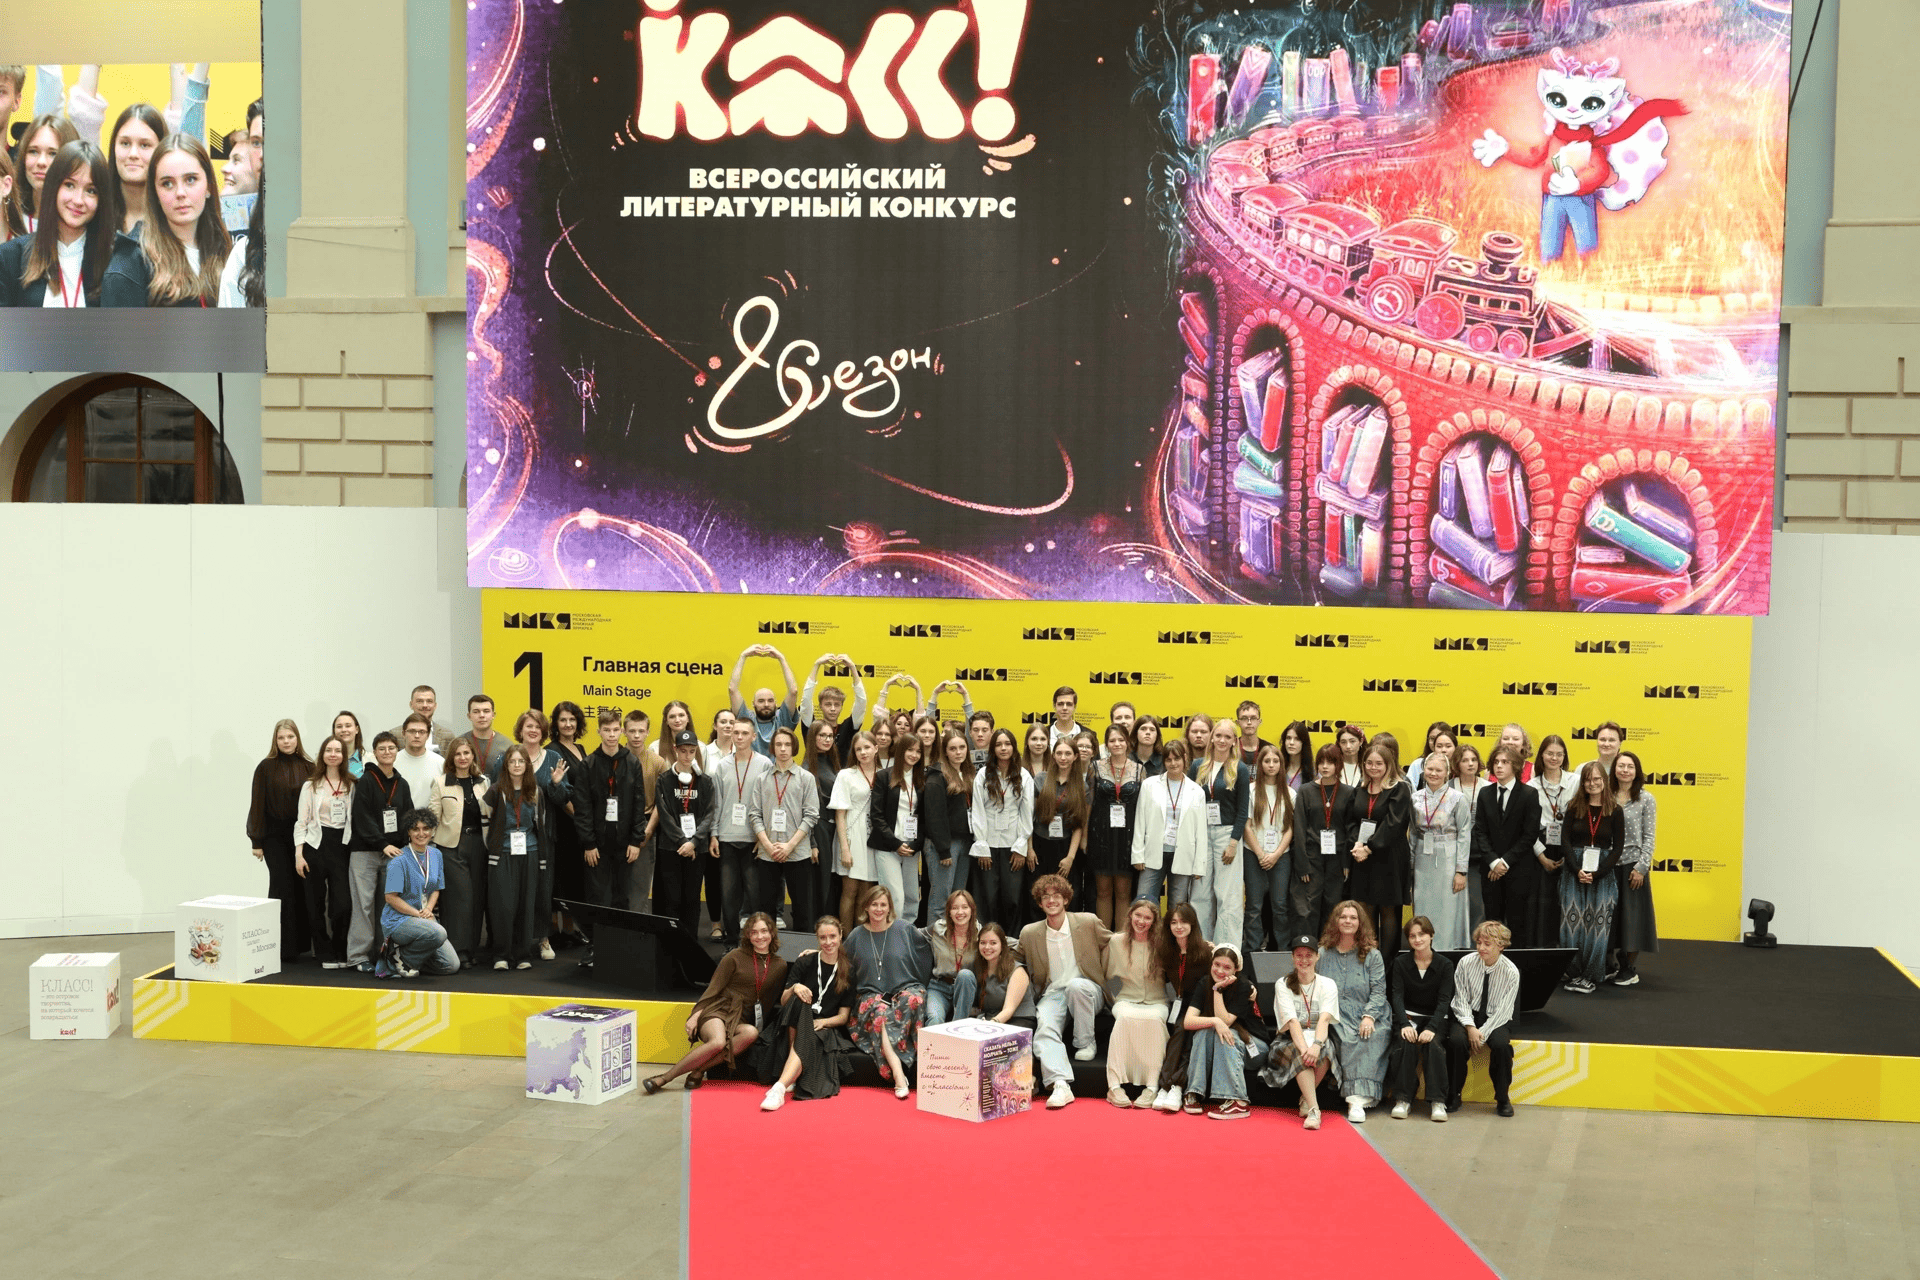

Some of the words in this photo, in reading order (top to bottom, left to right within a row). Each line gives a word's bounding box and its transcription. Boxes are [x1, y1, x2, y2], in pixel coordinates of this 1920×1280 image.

[689, 164, 946, 188] ВСЕРОССИЙСКИЙ
[620, 193, 862, 218] ЛИТЕРАТУРНЫЙ
[870, 196, 1016, 218] КОНКУРС
[583, 656, 661, 673] Главная
[666, 661, 723, 676] сцена
[514, 651, 543, 711] 1
[583, 685, 612, 696] Main
[616, 686, 651, 699] Stage
[41, 979, 93, 992] КЛАСС!
